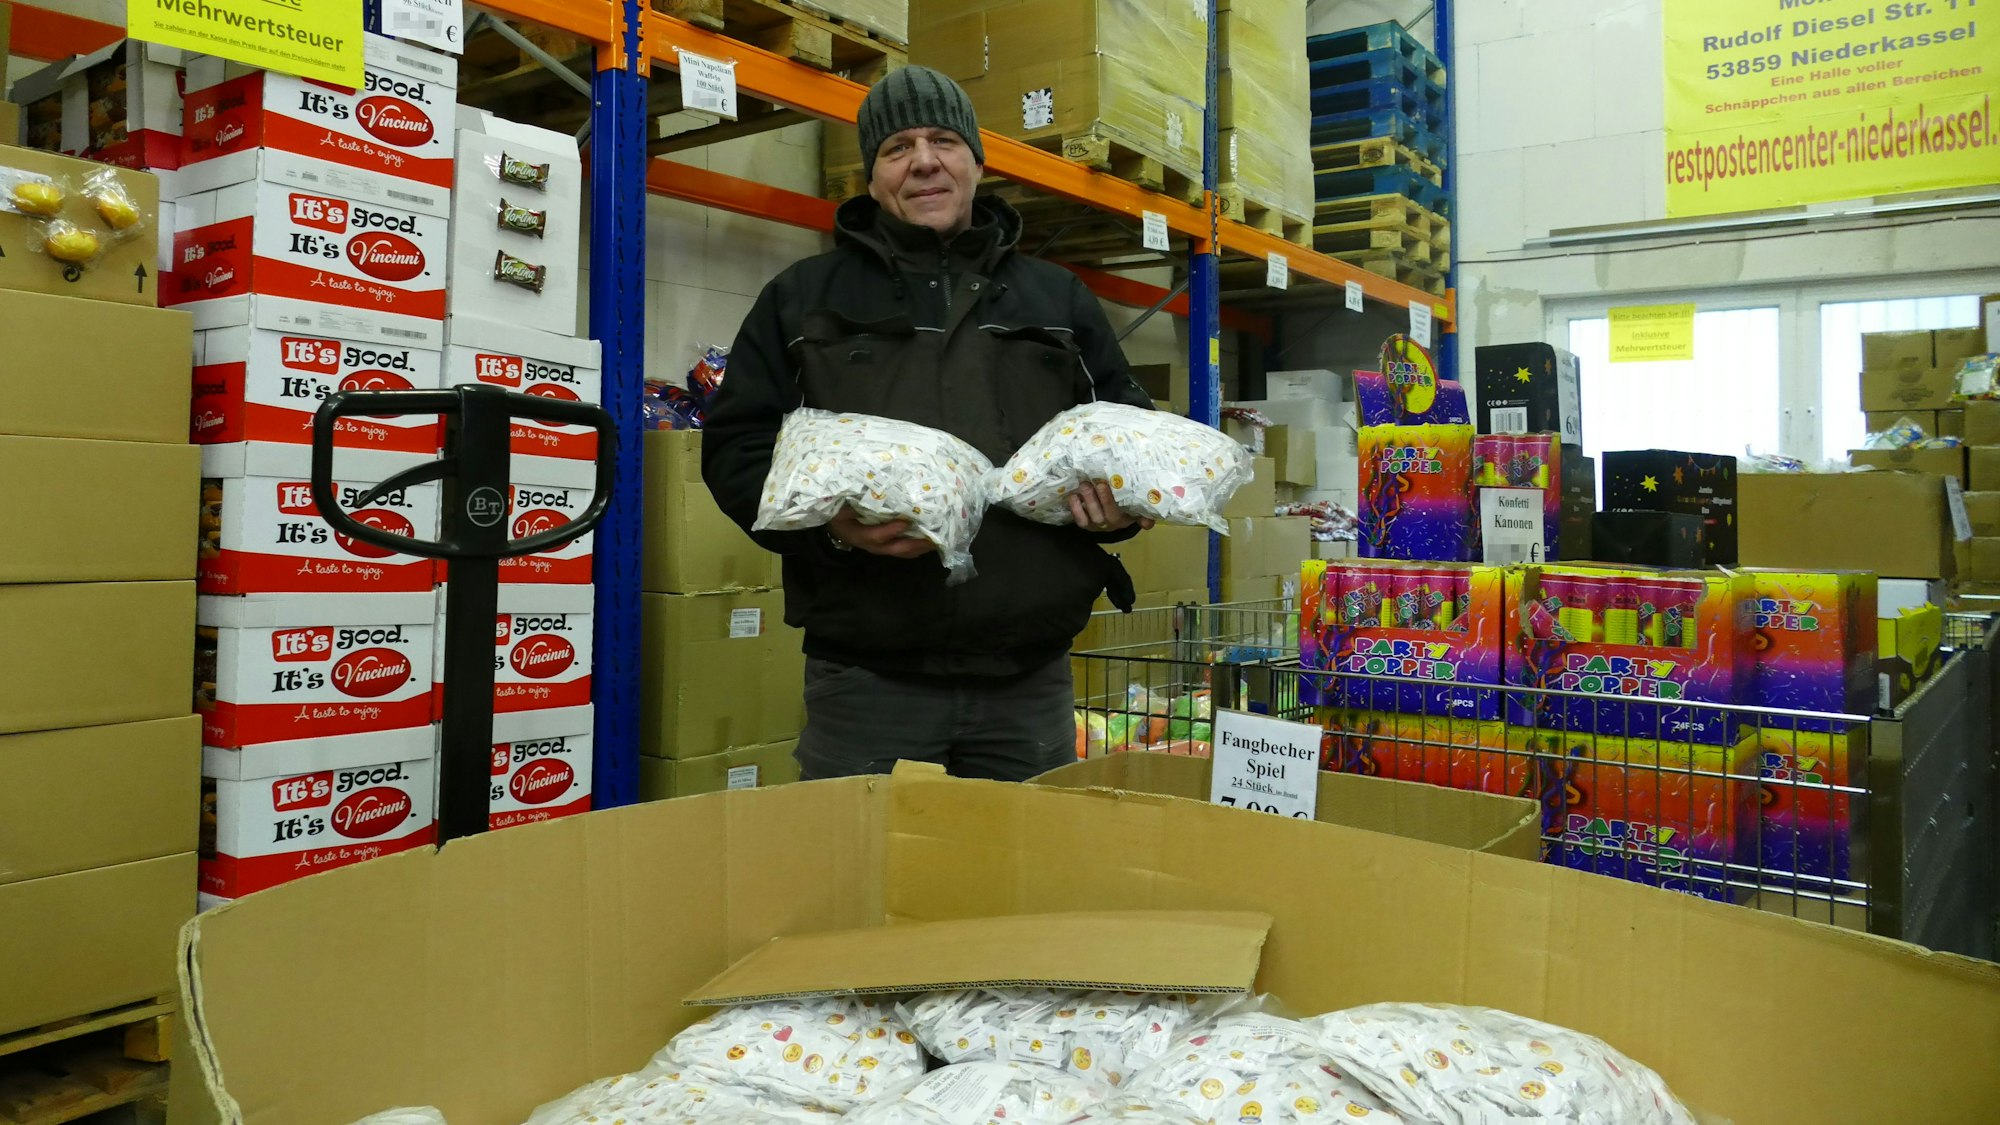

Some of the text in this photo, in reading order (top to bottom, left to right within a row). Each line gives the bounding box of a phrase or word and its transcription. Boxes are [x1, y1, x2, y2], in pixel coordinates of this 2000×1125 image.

[446, 25, 458, 43] €
[1703, 24, 1782, 52] Rudolf
[1793, 8, 1875, 38] Diesel
[1885, 1, 1932, 21] Str.
[154, 21, 346, 72] Sie zahlen an der Kasse den Preis der auf den Preisschildern steht
[1706, 21, 1976, 81] 53859 Niederkassel
[683, 56, 700, 67] Mini
[1771, 58, 1904, 88] Eine Halle voller
[364, 71, 432, 105] good.
[696, 80, 725, 94] 100 Stück
[1705, 65, 1983, 115] Schnäppchen aus allen Bereichen
[298, 91, 350, 120] It's
[721, 98, 728, 112] €
[320, 131, 405, 168] A taste to enjoy.
[293, 198, 423, 237] It's good.
[289, 233, 340, 258] It's
[310, 272, 396, 303] A taste to enjoy.
[285, 341, 415, 372] It's good.
[1616, 343, 1687, 353] Mehrwertsteuer
[478, 357, 581, 385] It's good.
[1387, 373, 1432, 387] POPPER
[280, 377, 332, 401] It's
[346, 422, 358, 433] to
[361, 425, 389, 442] enjoy.
[528, 430, 537, 440] to
[538, 433, 561, 447] enjoy.
[1383, 447, 1439, 460] PARTY
[1380, 460, 1442, 474] POPPER
[517, 490, 574, 508] good.
[1498, 496, 1529, 510] Konfetti
[276, 523, 328, 544] It's
[1494, 514, 1533, 530] Kanonen
[1530, 542, 1540, 564] €
[297, 560, 384, 581] A taste to enjoy.
[518, 558, 528, 567] to
[529, 559, 552, 573] enjoy.
[514, 614, 572, 635] good.
[276, 624, 409, 658] It's good.
[1355, 638, 1450, 660] PARTY
[1350, 655, 1455, 680] POPPER
[1566, 653, 1676, 678] PARTY
[272, 668, 324, 692] It's
[496, 684, 551, 699] taste to enjoy.
[1562, 672, 1682, 700] POPPER
[294, 703, 381, 723] A taste to enjoy.
[513, 737, 572, 763] good.
[1222, 731, 1315, 761] Fangbecher
[1246, 758, 1286, 779] Spiel
[276, 762, 409, 807] It's good.
[1232, 777, 1243, 787] 24
[1245, 779, 1273, 794] Stück
[273, 815, 324, 843] It's
[496, 816, 516, 827] taste
[517, 813, 527, 824] to
[1568, 814, 1676, 844] PARTY
[295, 845, 381, 870] A taste to enjoy.
[1563, 833, 1682, 868] POPPER
